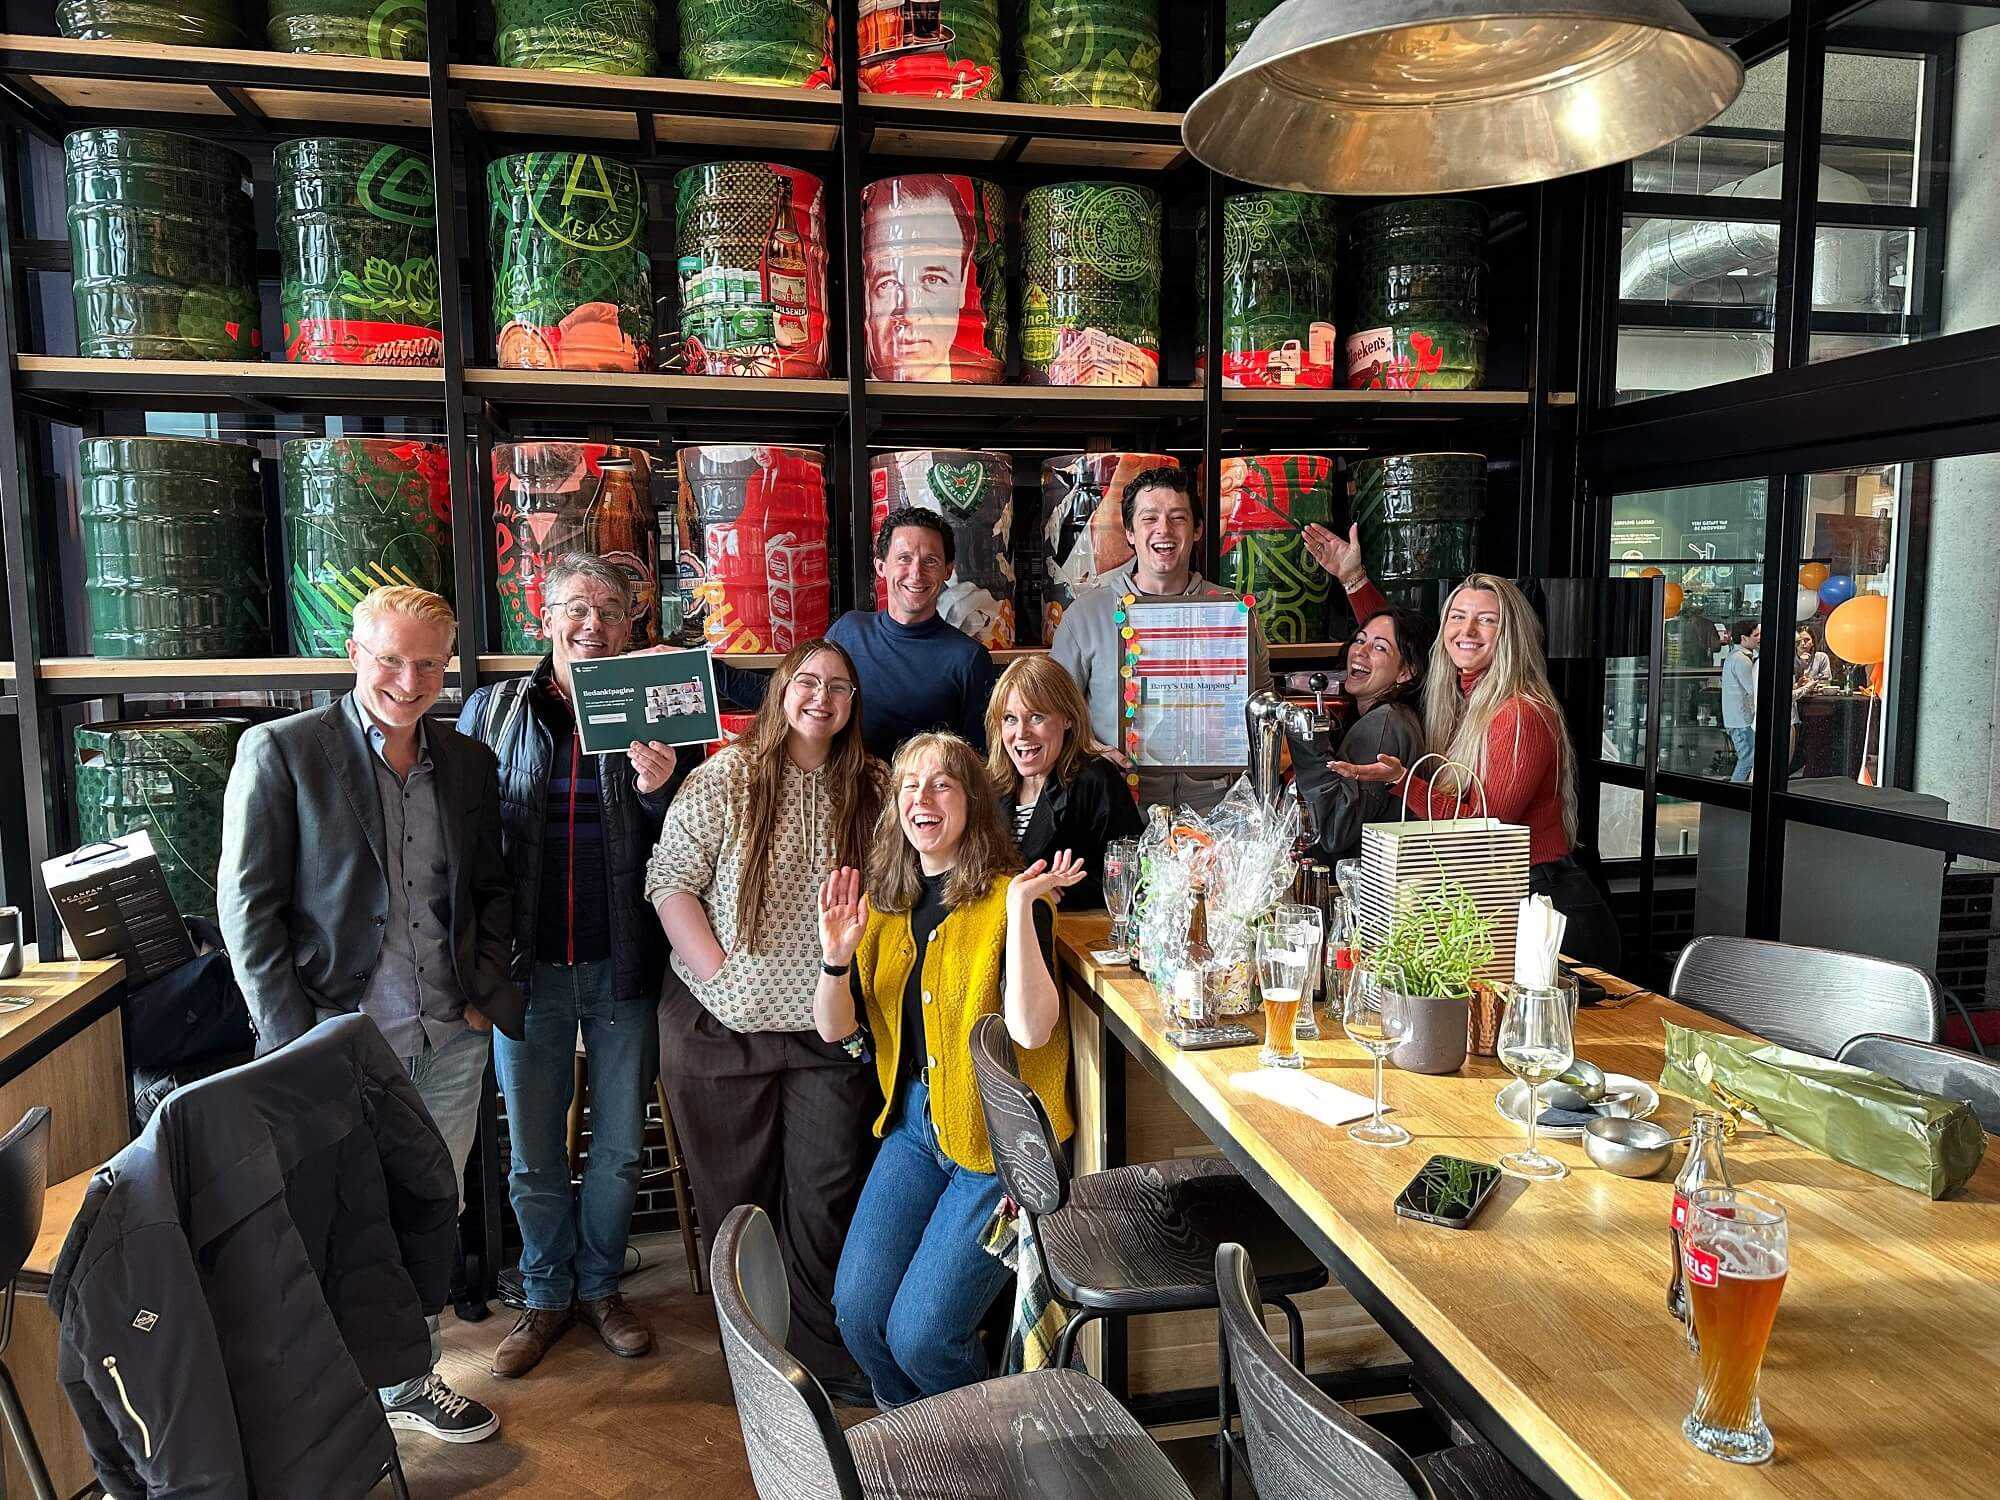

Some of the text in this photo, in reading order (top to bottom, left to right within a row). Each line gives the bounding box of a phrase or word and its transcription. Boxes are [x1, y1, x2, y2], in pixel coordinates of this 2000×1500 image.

[559, 211, 624, 241] YEAST
[775, 304, 807, 317] PILSENER
[1196, 682, 1231, 692] Mapping
